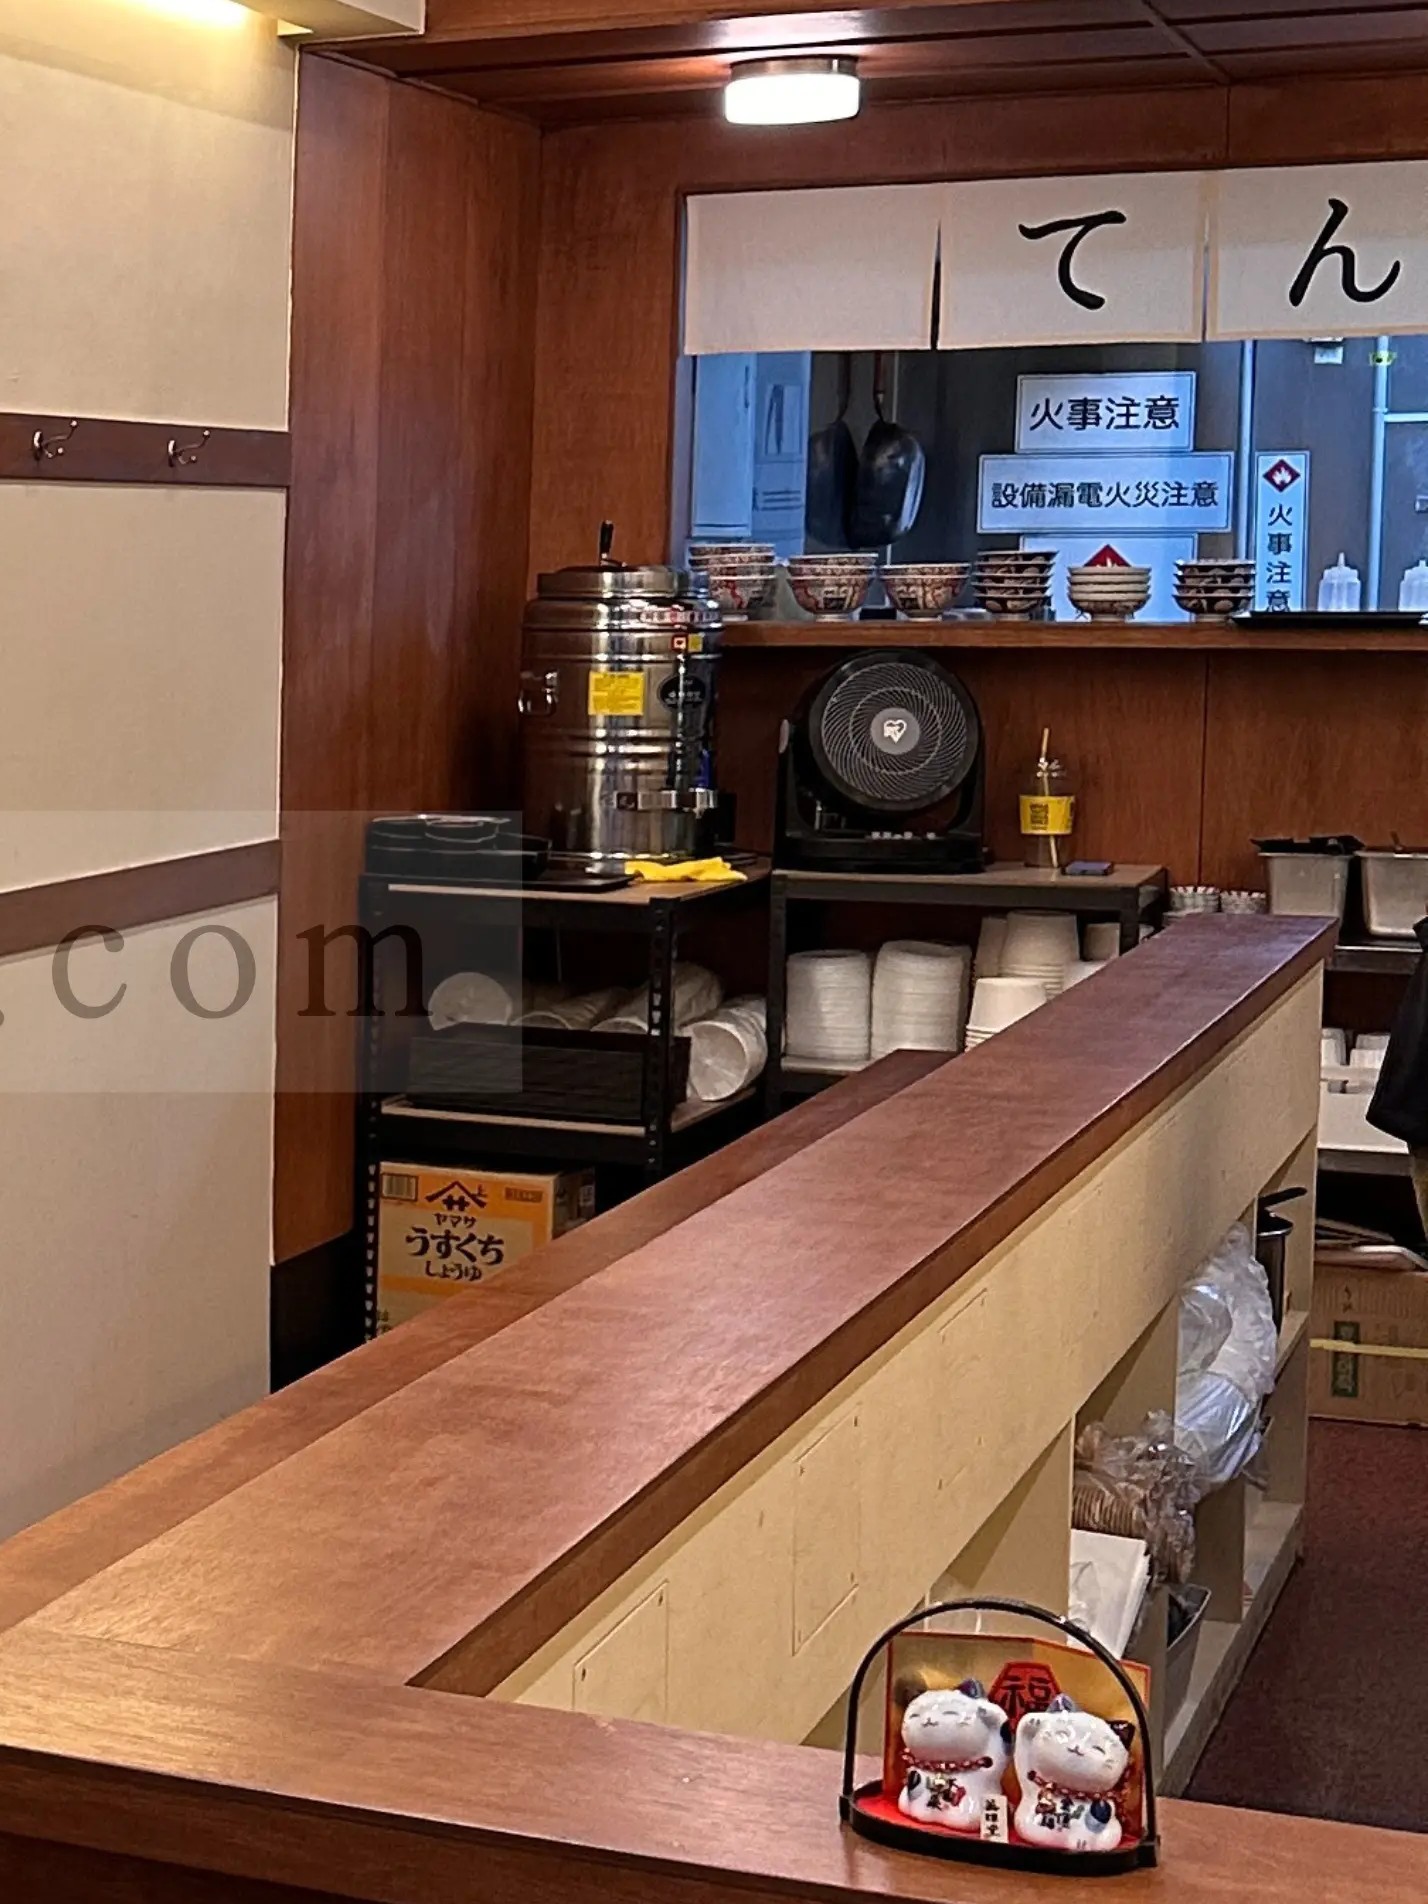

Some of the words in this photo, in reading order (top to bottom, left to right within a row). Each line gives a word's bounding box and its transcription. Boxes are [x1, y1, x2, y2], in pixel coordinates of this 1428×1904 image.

[1028, 394, 1180, 432] 火事注意
[990, 480, 1220, 510] 設備漏電火災注意
[1265, 503, 1294, 613] 火事注意
[434, 1212, 477, 1229] ヤマサ
[405, 1226, 505, 1266] うすくち
[424, 1261, 483, 1282] しょうゆ
